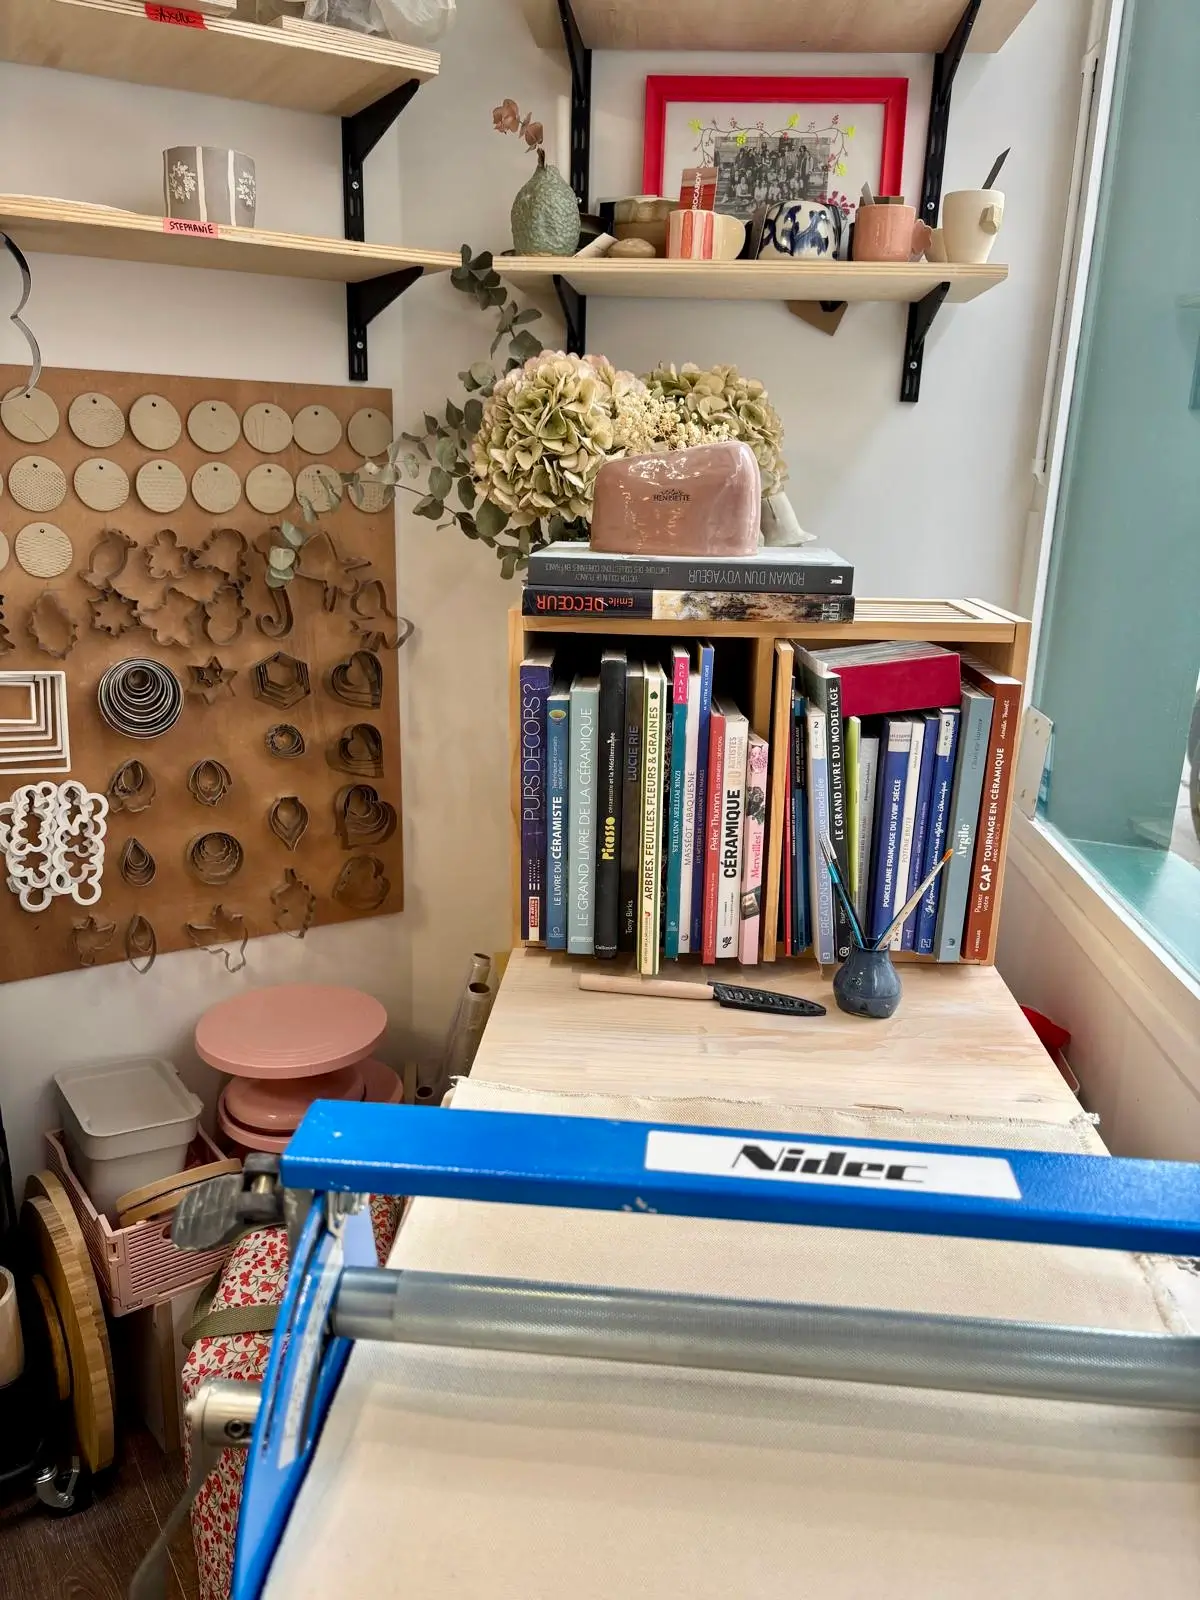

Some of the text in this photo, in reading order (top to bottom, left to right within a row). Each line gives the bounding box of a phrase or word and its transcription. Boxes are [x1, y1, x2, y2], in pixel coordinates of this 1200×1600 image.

[691, 172, 702, 210] ROCABOY
[688, 569, 740, 585] VOYAGEUR
[769, 572, 805, 586] ROMAN
[648, 707, 658, 755] GRAINES
[814, 721, 820, 729] 2
[577, 708, 592, 785] CÉRAMIQUE
[627, 726, 639, 781] LUCIE RIE
[648, 756, 656, 764] &
[728, 736, 738, 768] ARTISTES
[829, 687, 844, 840] LE GRAND LIVRE DU MODELAGE
[523, 775, 541, 820] PURS
[580, 788, 590, 804] LA
[647, 766, 656, 805] FLEURS
[814, 778, 825, 817] modelée
[891, 779, 901, 802] SIÈCLE
[937, 780, 948, 813] céramique
[579, 809, 590, 825] DE
[673, 789, 681, 818] POTTERY
[683, 771, 695, 866] MASSÉOT ABAQUESNE
[979, 747, 1004, 891] CAP TOURNAGE EN CÉRAMIQUE
[550, 796, 563, 859] CÉRAMISTE
[601, 817, 616, 860] Picasso
[709, 830, 718, 850] Peter
[720, 789, 741, 878] CÉRAMIQUE
[889, 821, 897, 831] DU
[933, 819, 944, 838] objets
[956, 824, 972, 858] Argile
[579, 830, 590, 860] LIVRE
[886, 832, 897, 867] FRANÇAISE
[553, 861, 561, 873] DU
[553, 875, 561, 896] LIVRE
[577, 864, 589, 910] GRAND
[883, 867, 893, 907] PORCELAINE
[578, 913, 589, 926] LE
[624, 900, 634, 934] Tony Birks
[974, 894, 984, 913] Passez
[982, 896, 990, 912] votre
[731, 1144, 929, 1184] Nidec
